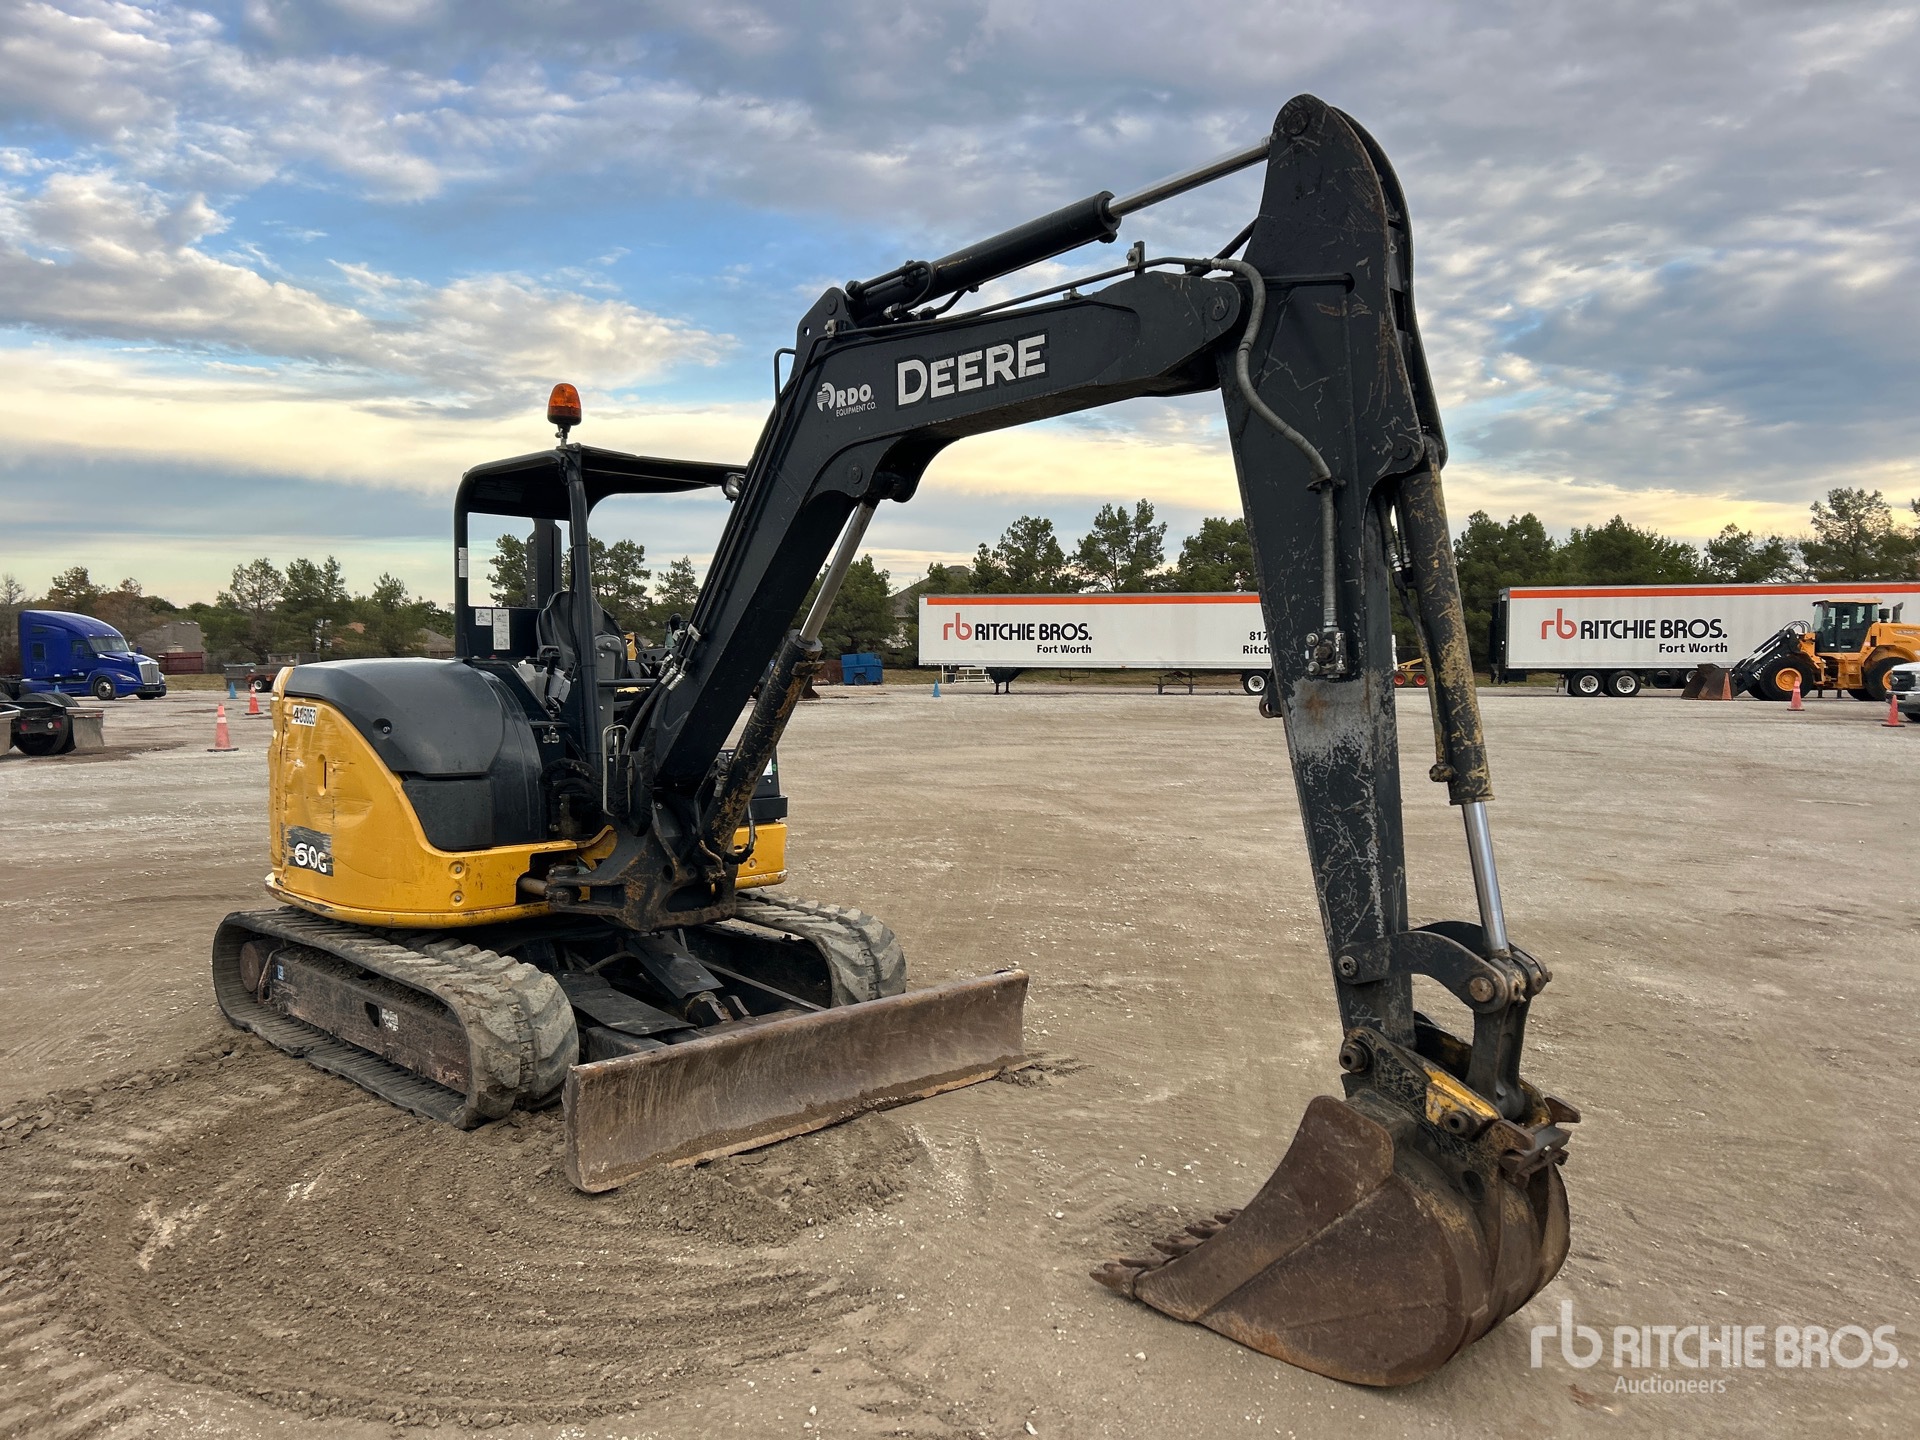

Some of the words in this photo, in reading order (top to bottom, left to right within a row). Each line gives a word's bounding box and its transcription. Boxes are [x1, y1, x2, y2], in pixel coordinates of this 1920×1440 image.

[897, 334, 1046, 406] DEERE
[836, 383, 872, 408] RDO
[835, 403, 866, 418] EQUIPMENT
[974, 623, 1035, 641] RITCHIE
[1038, 622, 1093, 641] BROS.
[1580, 619, 1656, 640] RITCHIE
[1660, 618, 1728, 639] BROS.
[1036, 644, 1059, 654] Fort
[1060, 644, 1092, 654] Worth
[1659, 643, 1686, 653] Fort
[1688, 642, 1728, 653] Worth
[294, 842, 327, 873] 60G
